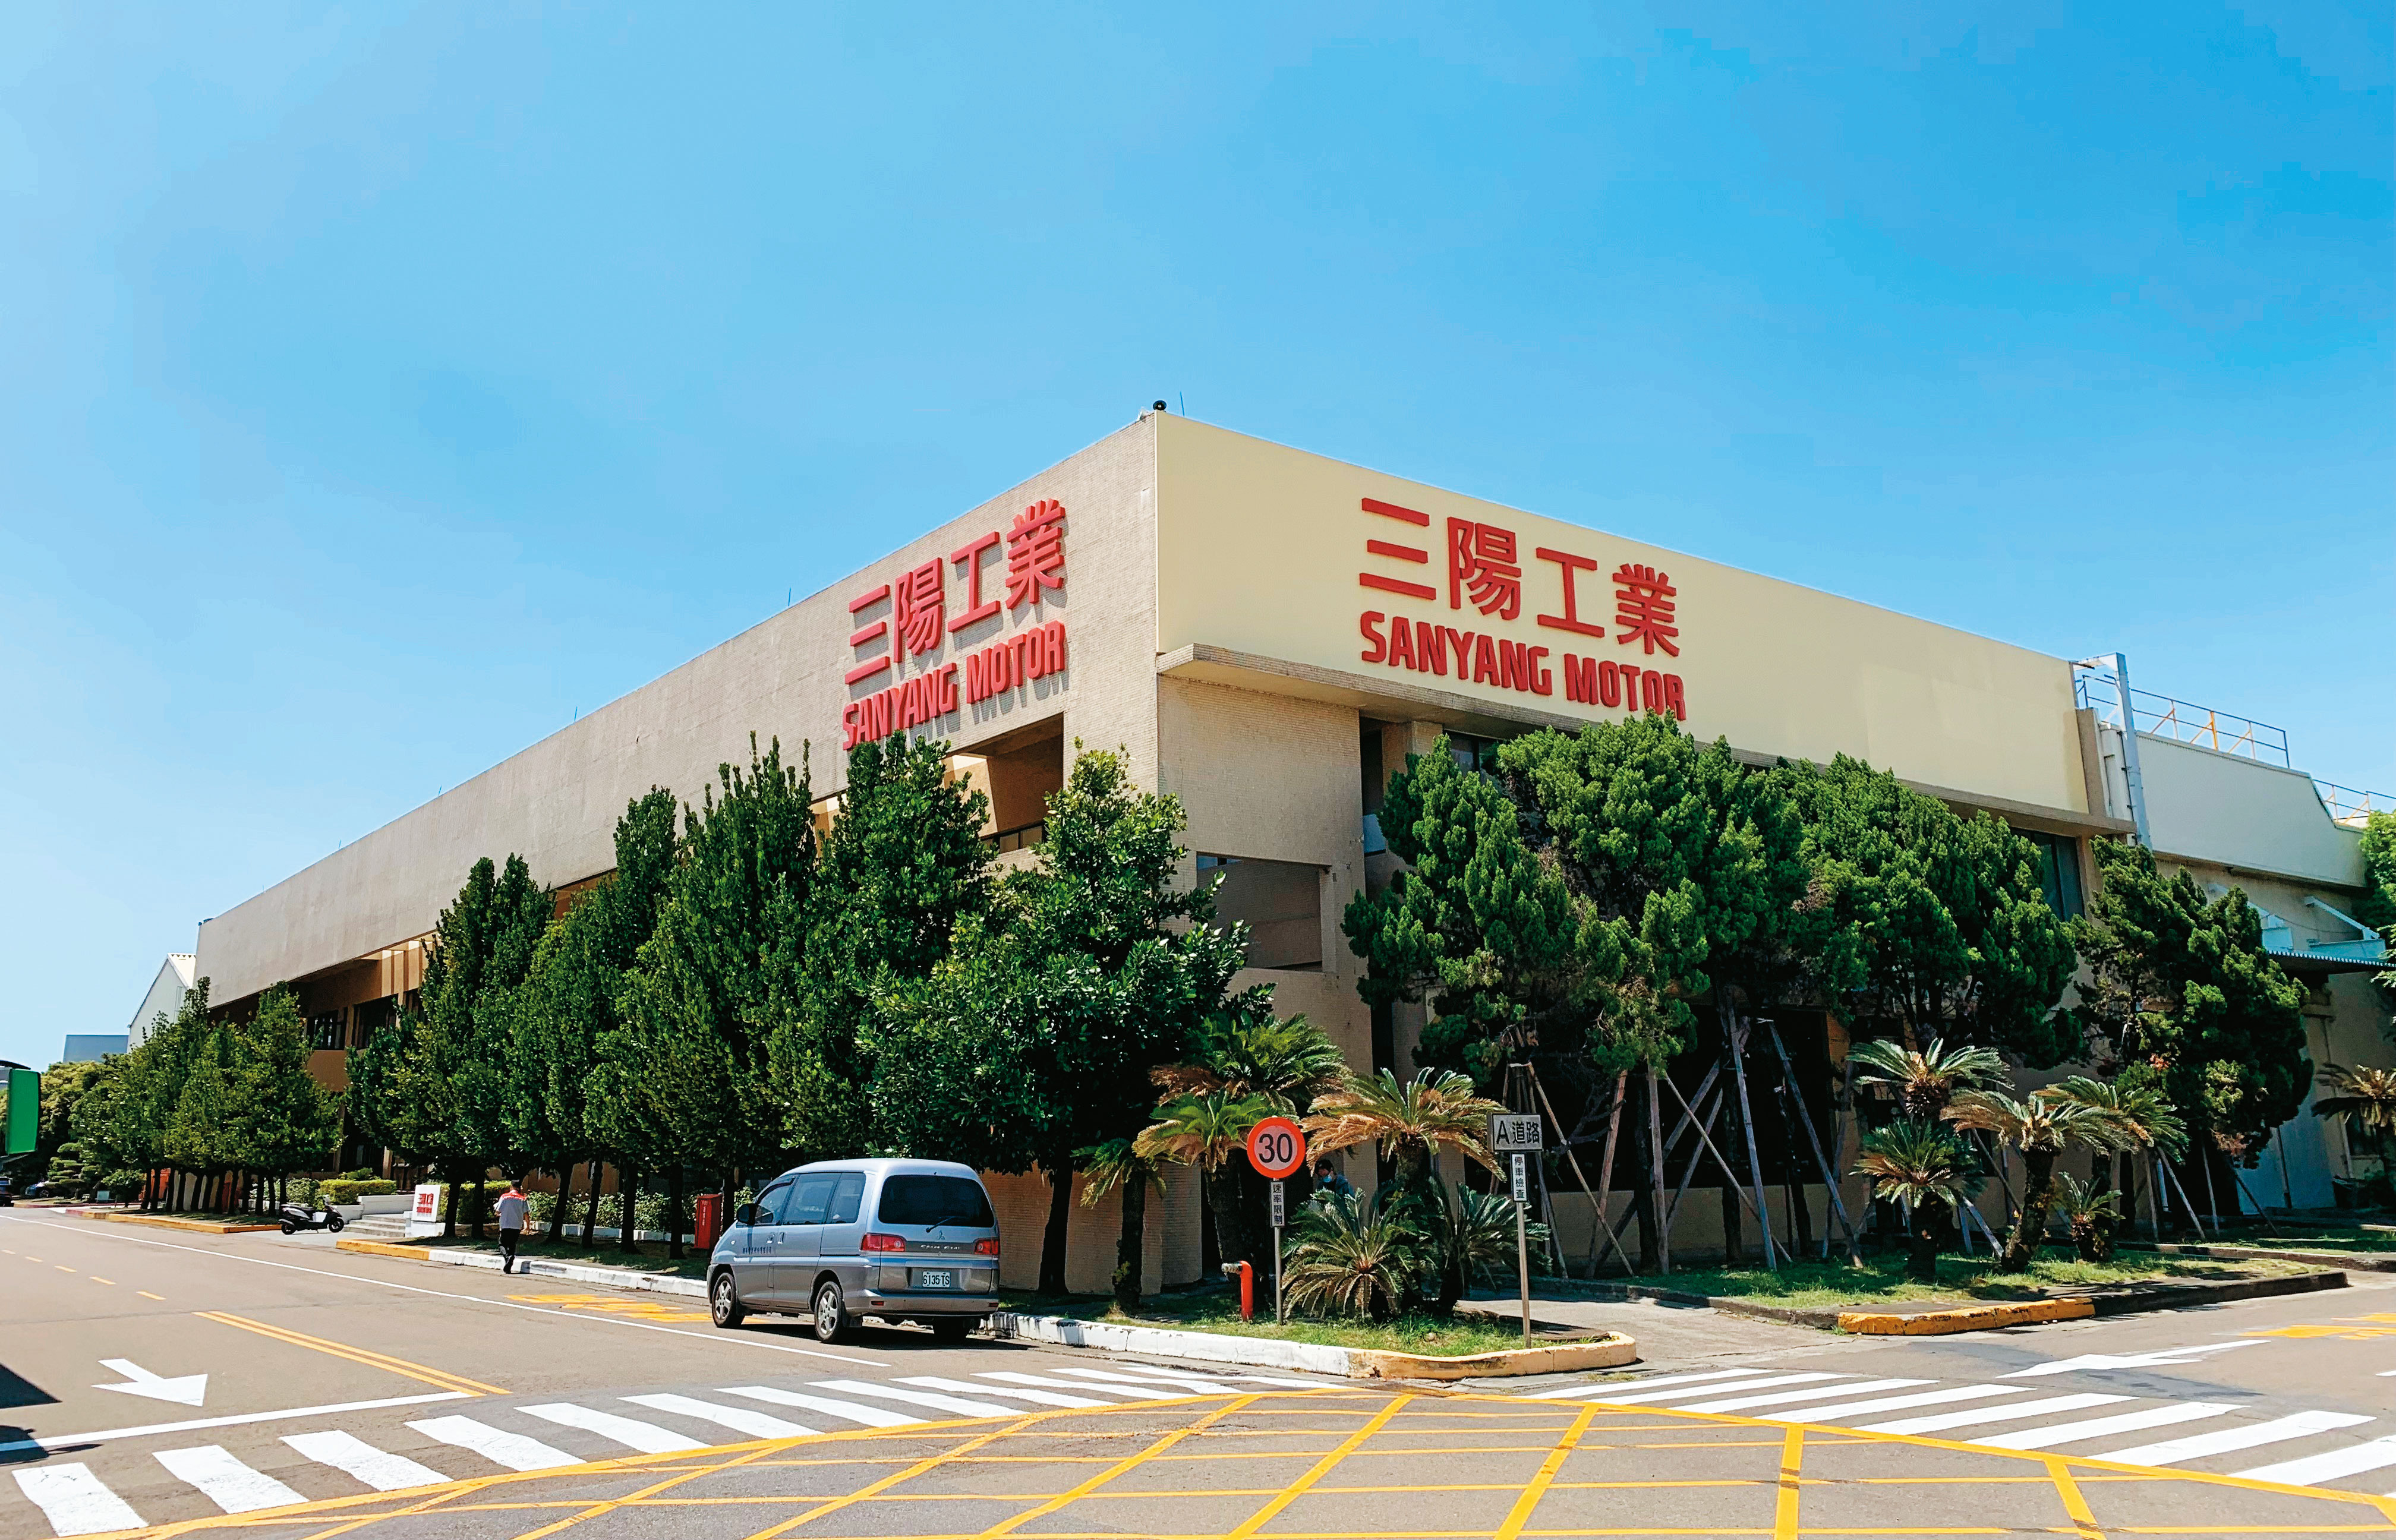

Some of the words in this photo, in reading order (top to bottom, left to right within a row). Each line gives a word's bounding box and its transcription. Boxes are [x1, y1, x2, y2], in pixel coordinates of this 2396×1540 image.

[844, 498, 1065, 686] 三陽工業
[1359, 497, 1680, 657] 三陽工業
[842, 662, 958, 751] SANYANG
[966, 620, 1065, 705] MOTOR
[1360, 610, 1553, 696] SANYANG
[1563, 653, 1686, 721] MOTOR
[1259, 1133, 1293, 1163] 30
[1496, 1120, 1540, 1144] A道路
[1514, 1156, 1525, 1198] 停車檢查
